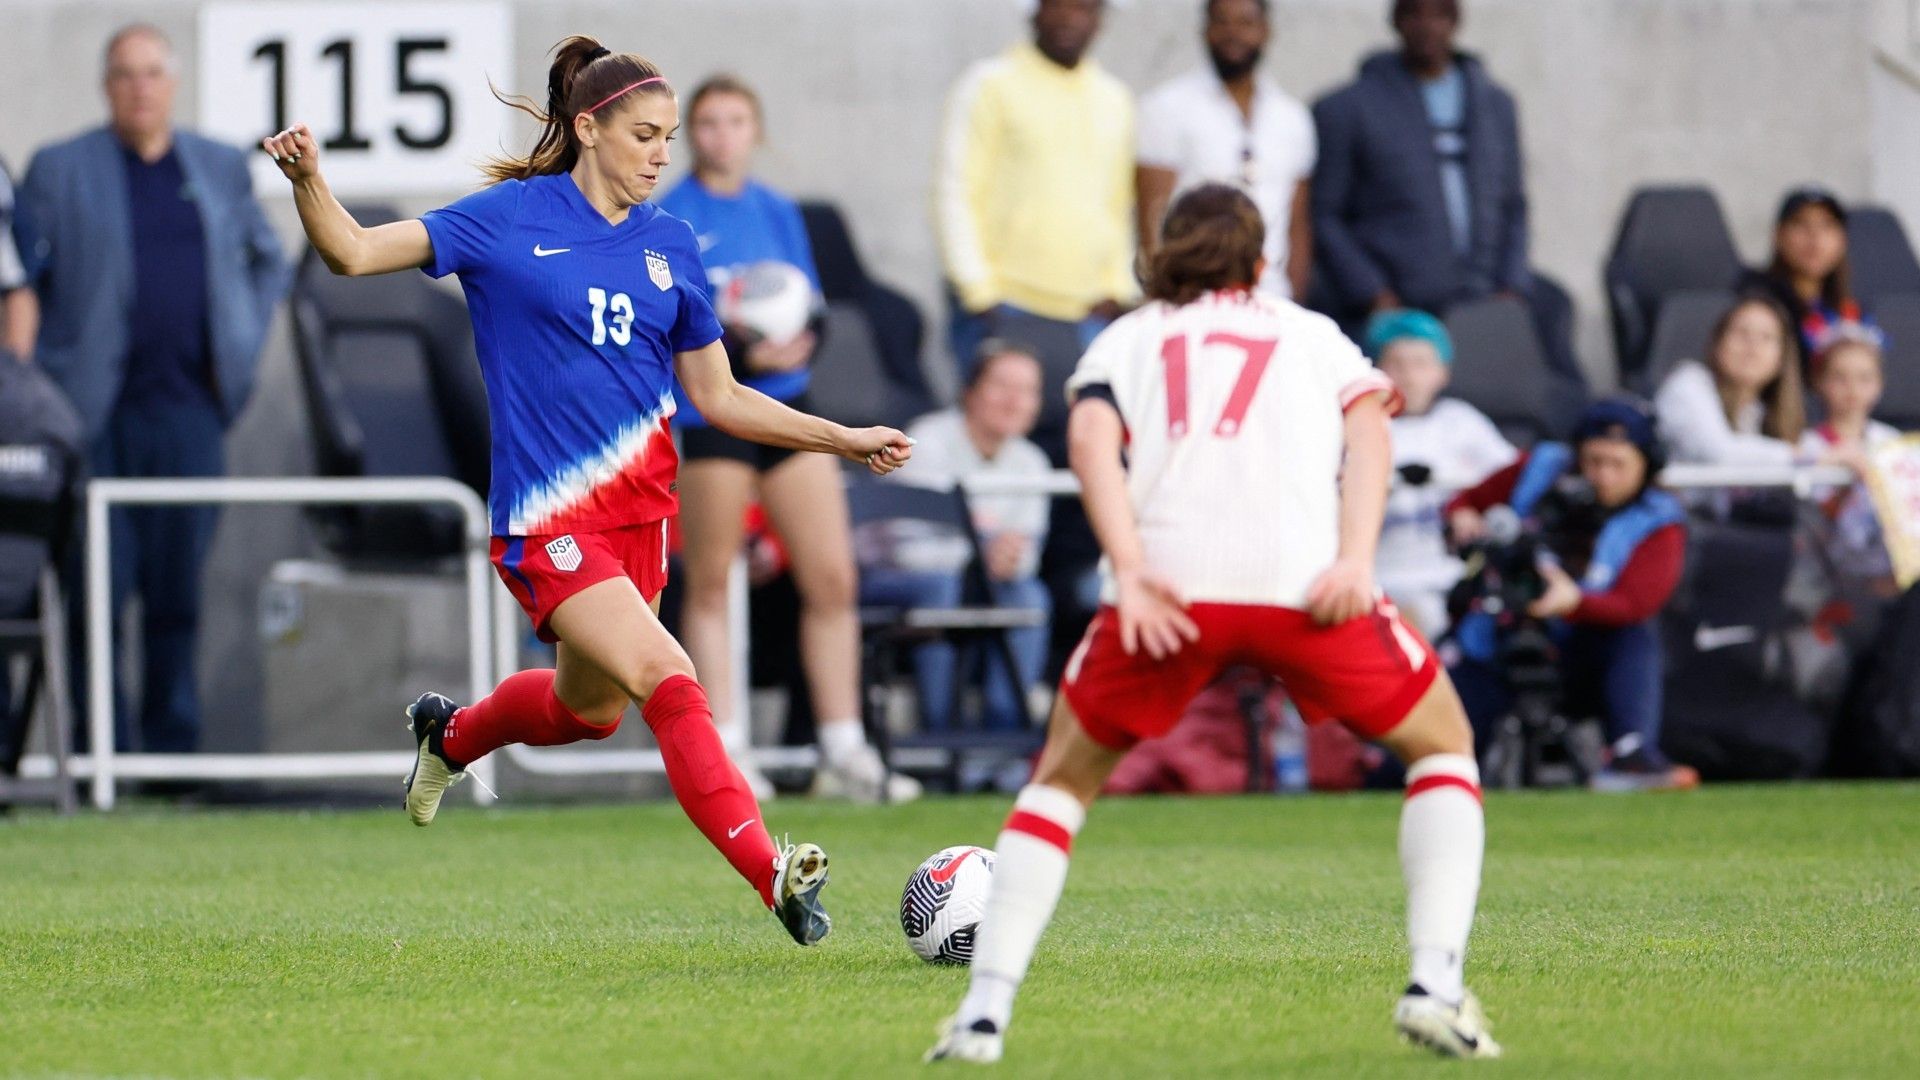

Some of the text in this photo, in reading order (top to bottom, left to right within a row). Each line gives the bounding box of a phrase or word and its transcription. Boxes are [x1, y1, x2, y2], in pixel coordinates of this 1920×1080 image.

[252, 37, 455, 152] 115
[647, 258, 669, 273] USA
[588, 287, 635, 347] 13
[1161, 332, 1280, 440] 17
[547, 536, 574, 555] USA
